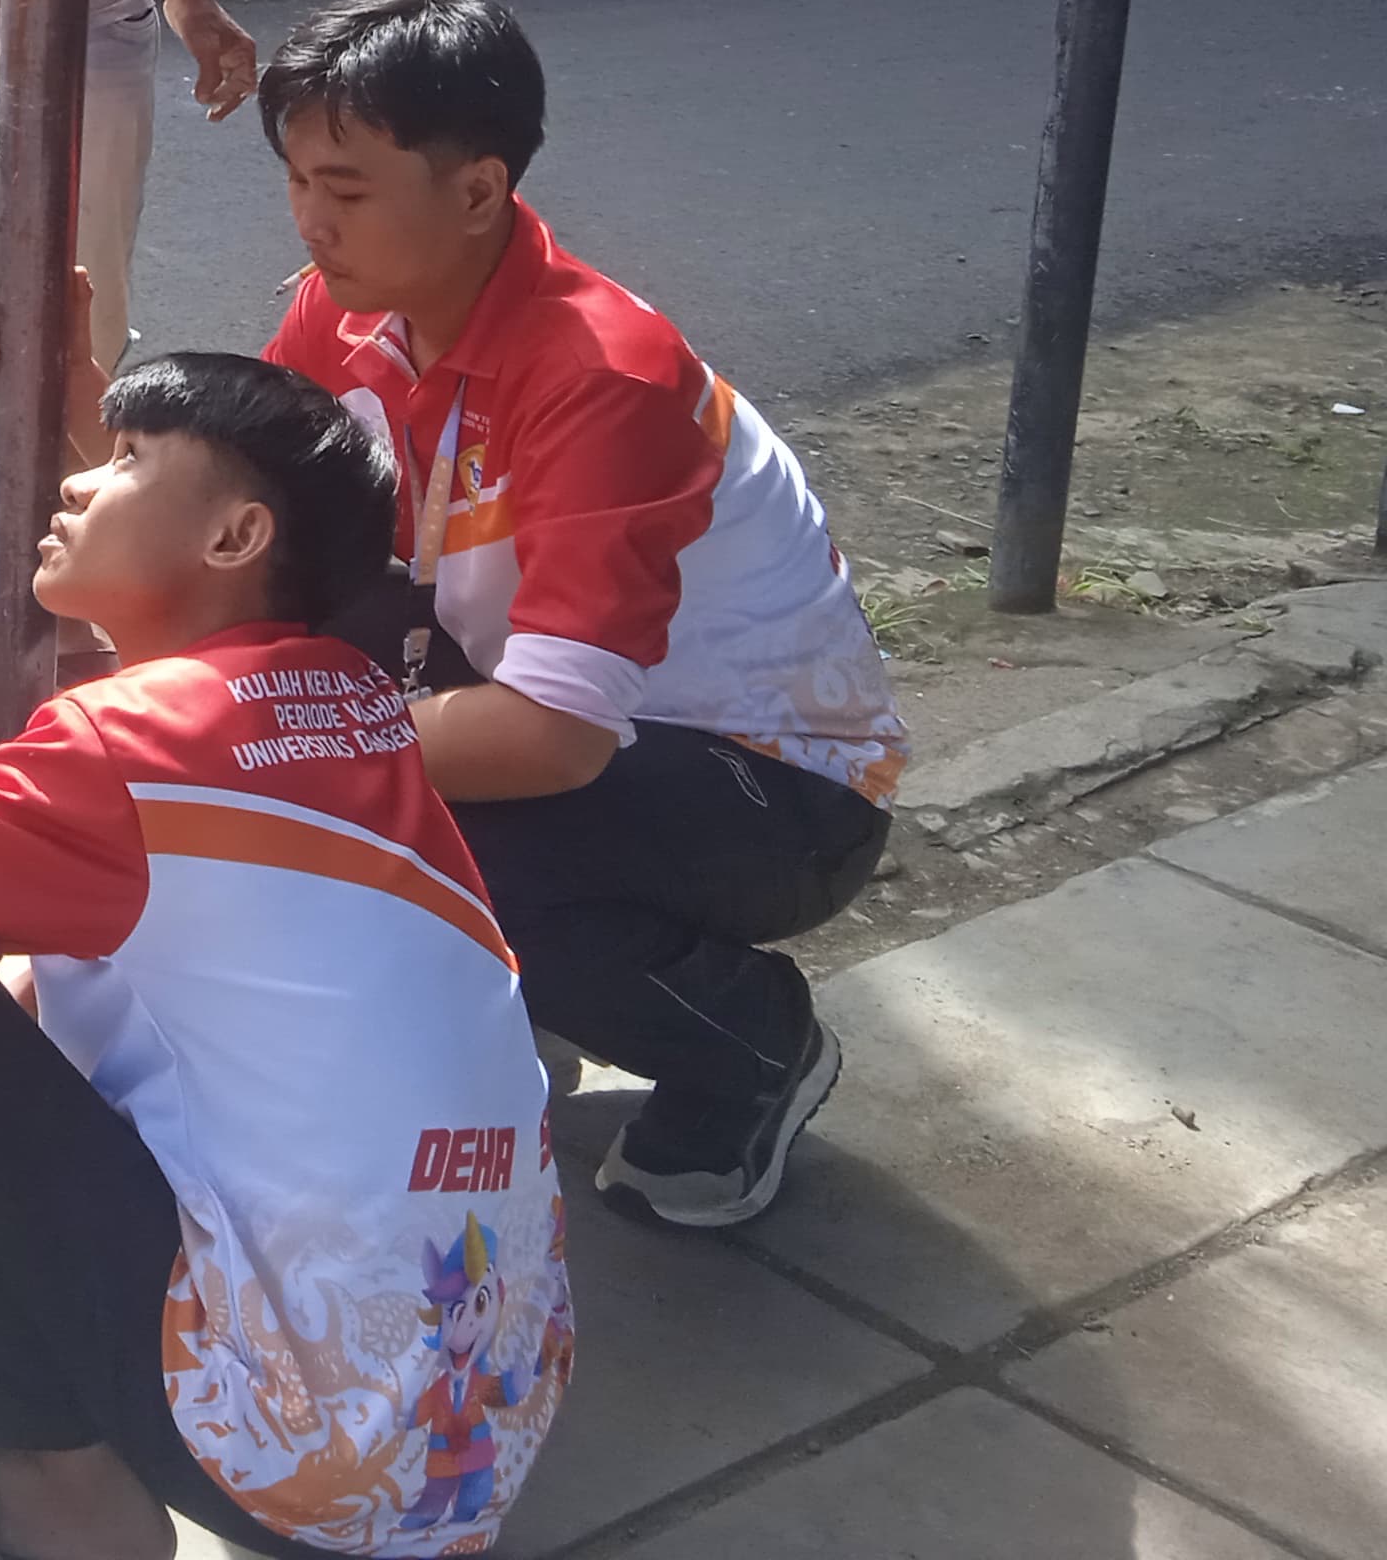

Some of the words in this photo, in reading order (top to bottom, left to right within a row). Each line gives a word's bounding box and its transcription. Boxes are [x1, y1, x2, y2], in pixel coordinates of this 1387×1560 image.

[226, 670, 301, 704] KULIAH
[303, 669, 356, 697] KERJA
[274, 703, 347, 730] PERIODE
[231, 734, 356, 771] UNIVERSITAS
[408, 1127, 516, 1192] DEHA
